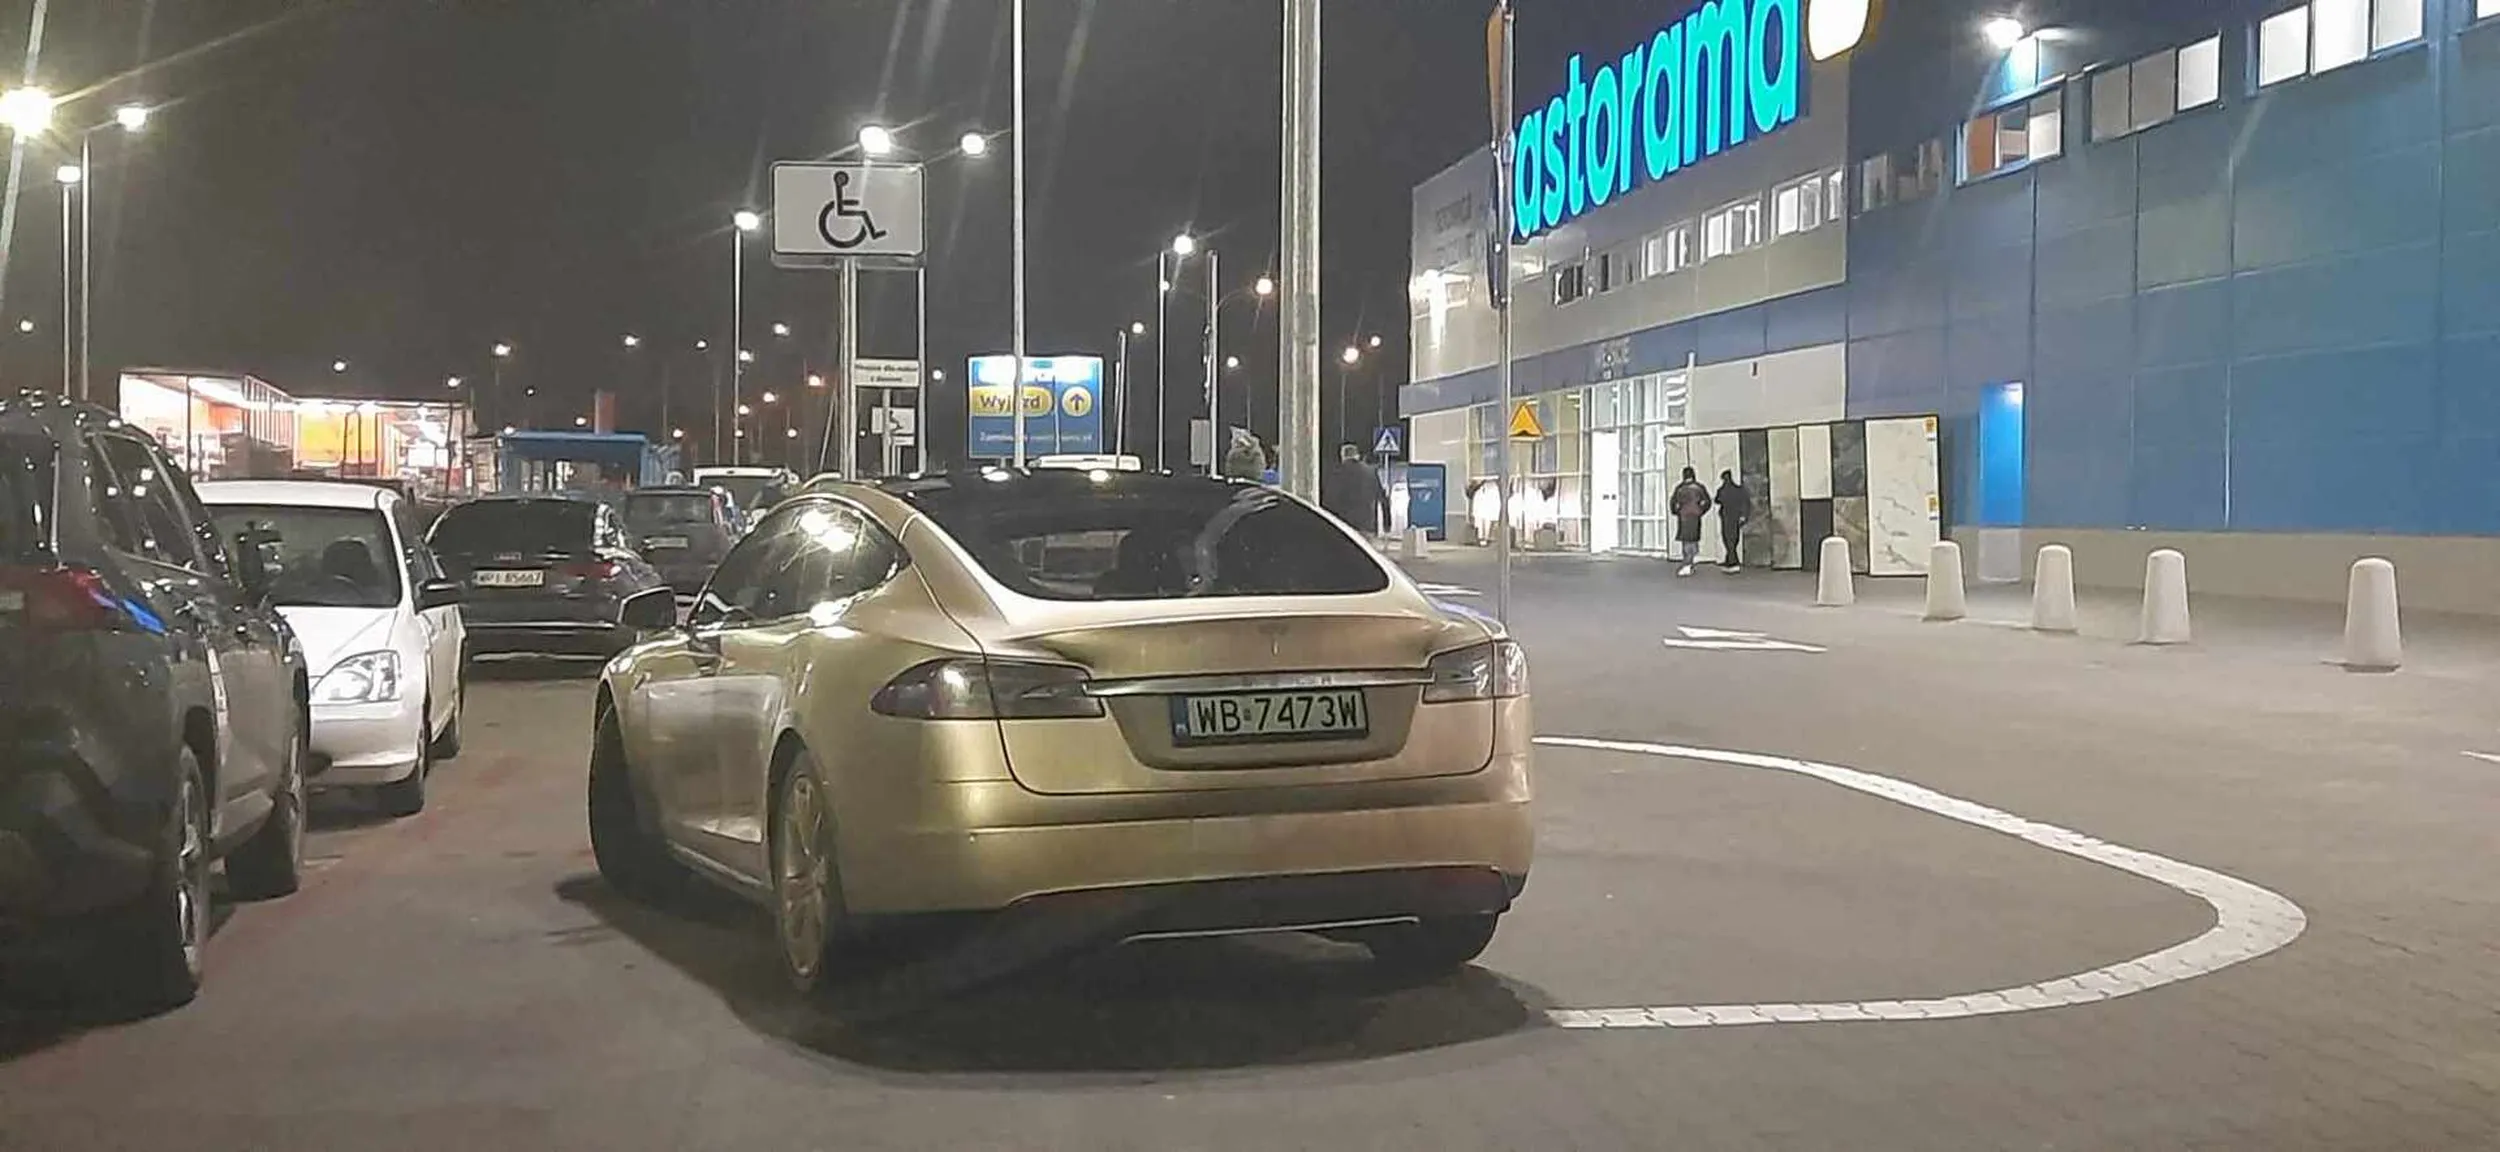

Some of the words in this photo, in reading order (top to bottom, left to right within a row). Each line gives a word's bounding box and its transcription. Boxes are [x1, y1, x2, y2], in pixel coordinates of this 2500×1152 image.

[1511, 0, 1798, 238] astorama
[979, 394, 1042, 413] Wyjzd
[1196, 699, 1241, 734] WB
[1253, 694, 1357, 732] 7473W
